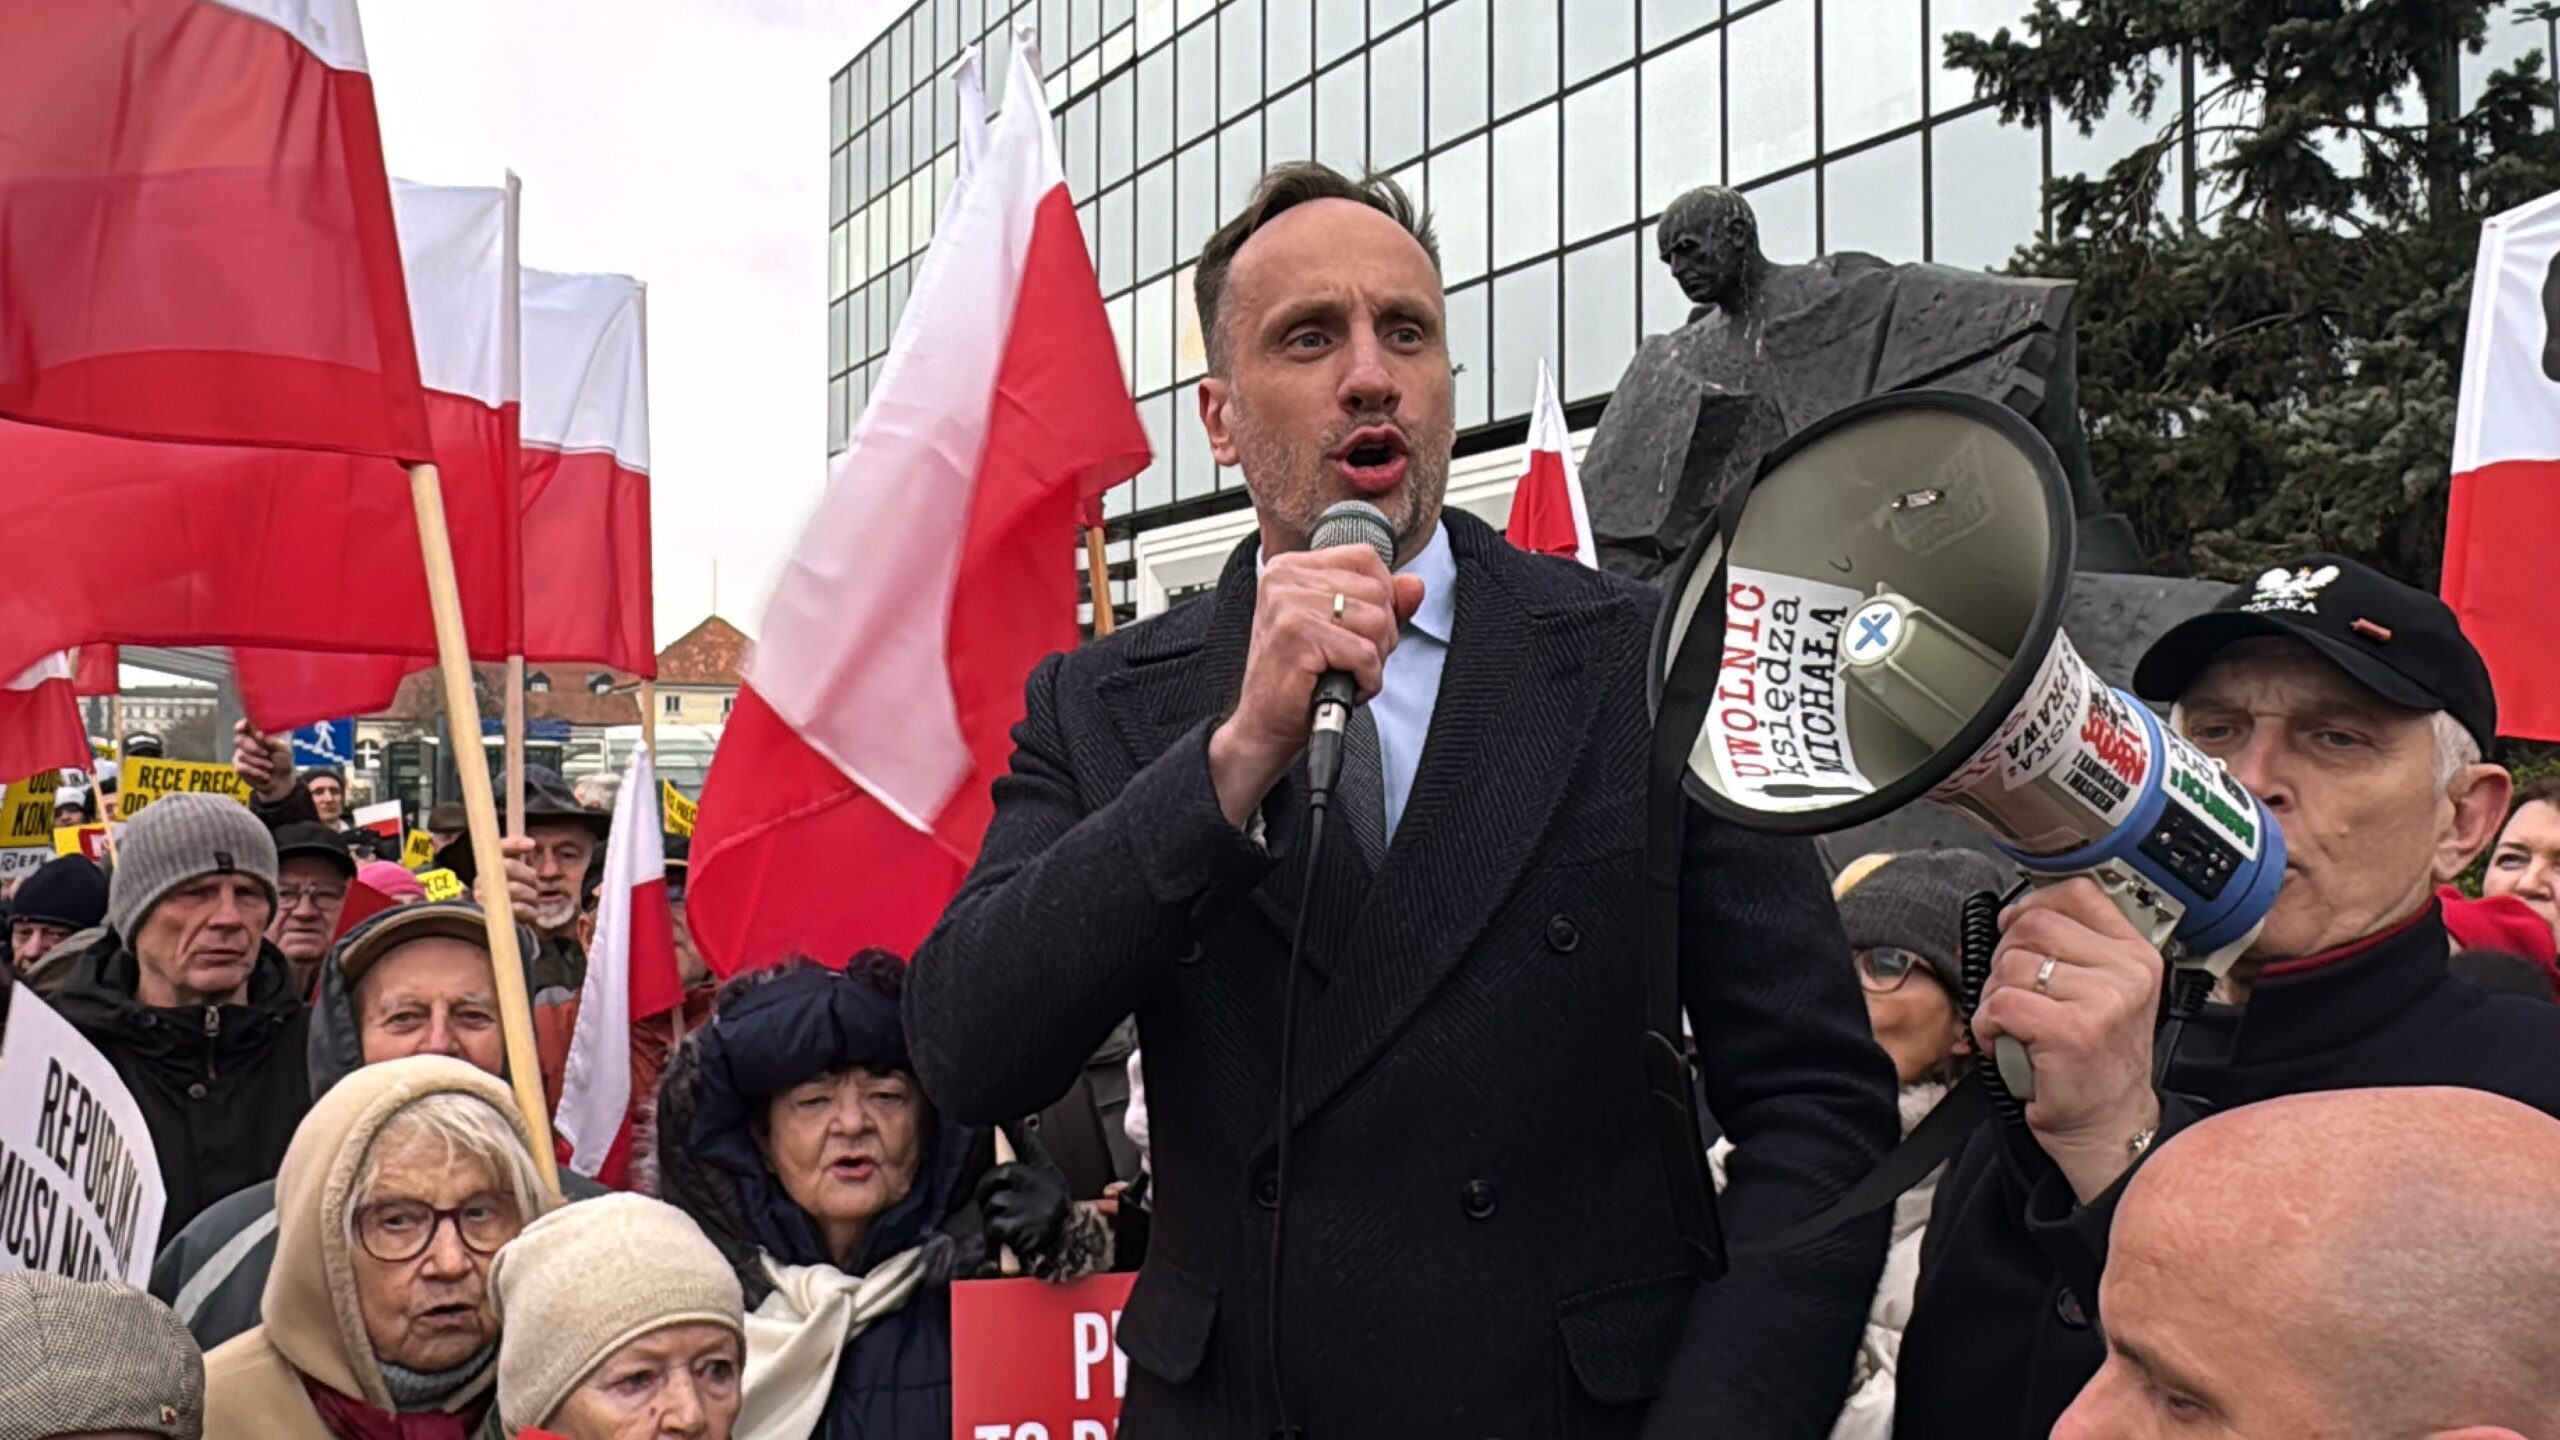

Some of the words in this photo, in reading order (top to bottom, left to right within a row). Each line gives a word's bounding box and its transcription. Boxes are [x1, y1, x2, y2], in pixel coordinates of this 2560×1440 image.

[1756, 596, 1810, 777] księdza
[1799, 606, 1851, 776] MICHAŁA
[138, 765, 186, 793] RĘCE
[188, 769, 242, 794] PRECZ
